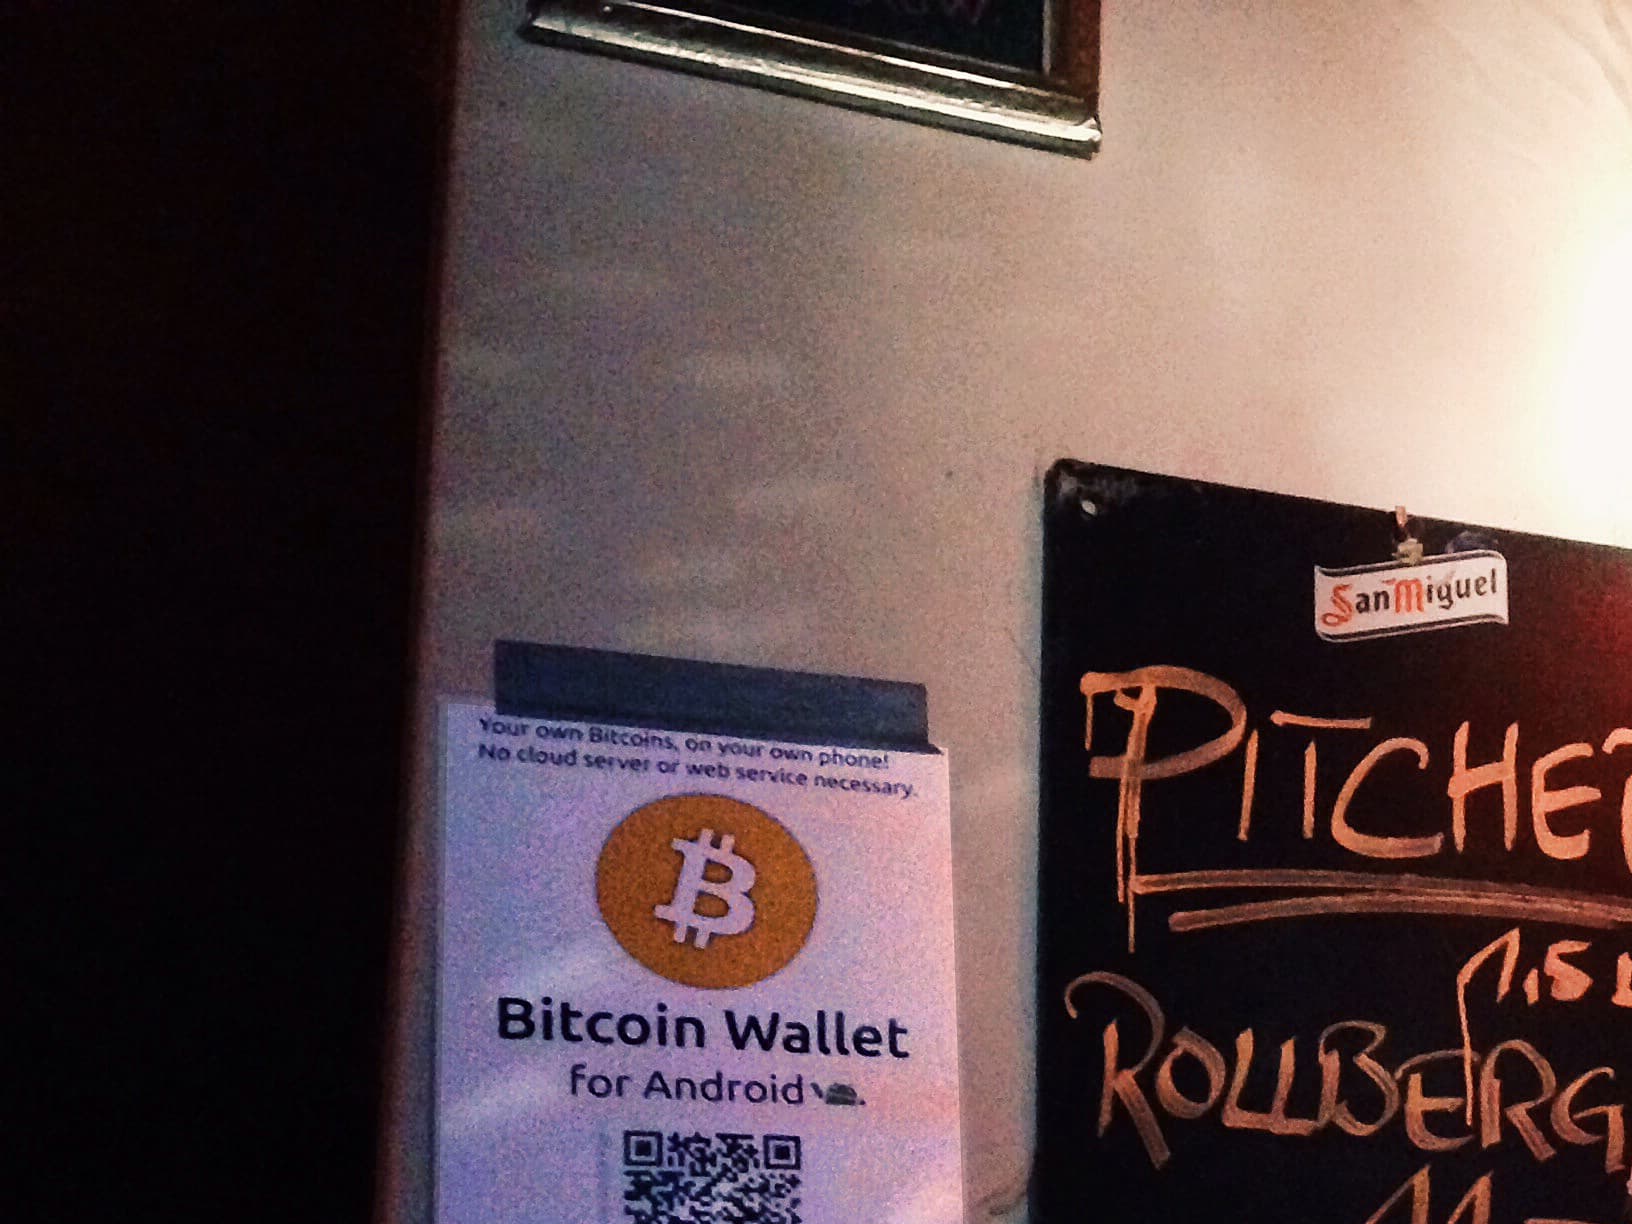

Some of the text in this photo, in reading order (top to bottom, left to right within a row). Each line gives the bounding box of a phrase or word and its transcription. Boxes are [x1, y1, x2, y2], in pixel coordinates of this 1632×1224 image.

[477, 742, 919, 800] No cloud server or web service necessary.
[479, 717, 889, 770] Your own Bitcoins, on your own phone!
[499, 997, 910, 1060] Bitcoin Wallet
[570, 1064, 805, 1105] for Android
